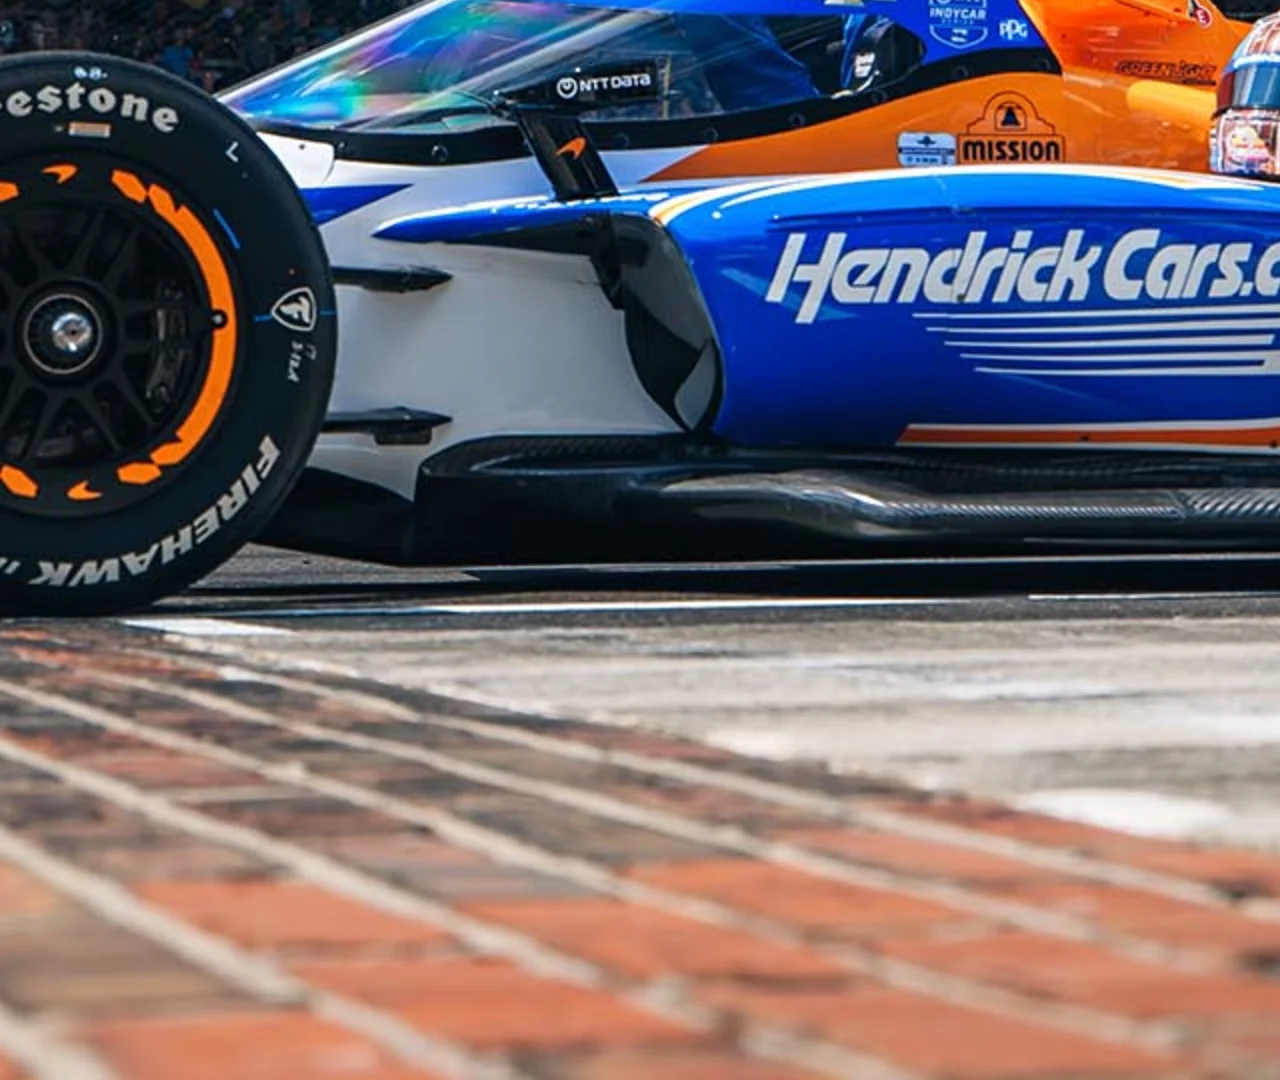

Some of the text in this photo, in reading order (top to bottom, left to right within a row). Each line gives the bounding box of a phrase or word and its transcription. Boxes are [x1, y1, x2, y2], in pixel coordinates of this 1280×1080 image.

[930, 7, 987, 20] INDYCAR
[999, 19, 1028, 41] PPG
[580, 77, 609, 92] NTT
[28, 434, 282, 588] FIREHAWK
